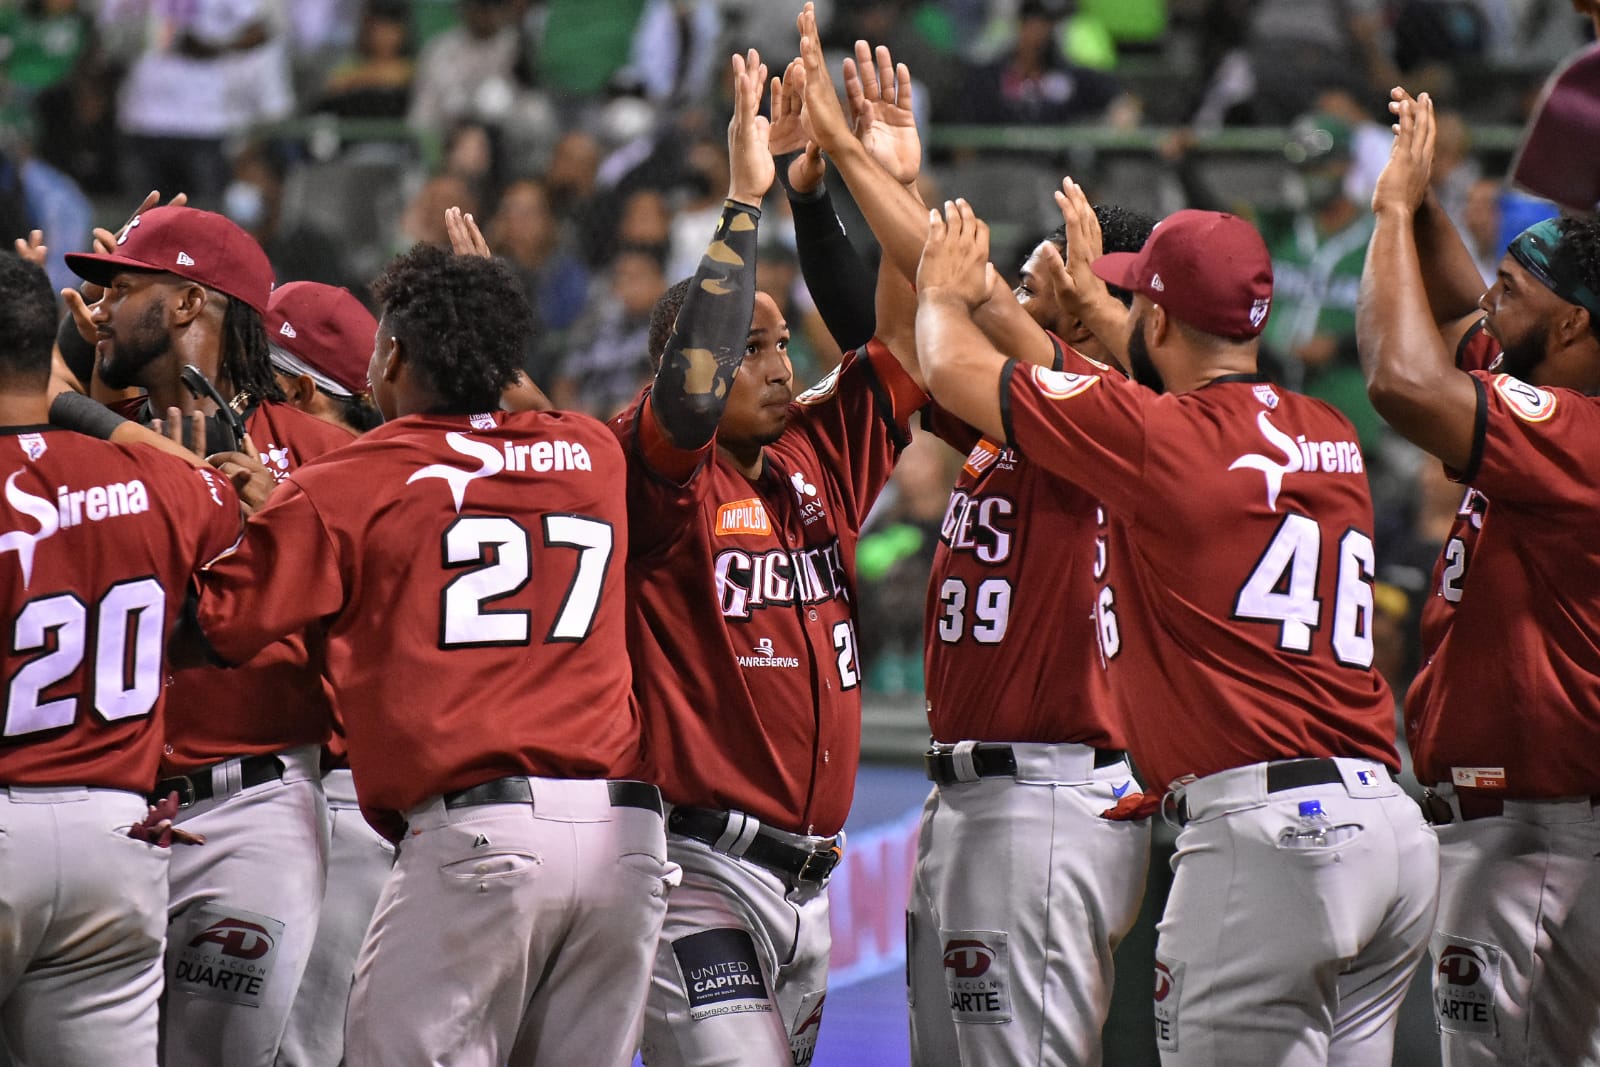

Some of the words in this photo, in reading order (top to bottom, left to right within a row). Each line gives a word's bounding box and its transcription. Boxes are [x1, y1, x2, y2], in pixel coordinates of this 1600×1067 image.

[406, 431, 592, 515] Sirena
[1228, 410, 1364, 513] Sirena
[0, 466, 149, 591] Sirena
[722, 506, 767, 530] IMPULSO
[440, 515, 614, 649] 27
[939, 578, 1012, 644] 39
[1231, 511, 1375, 669] 46
[3, 576, 165, 738] 20
[832, 618, 861, 688] 2
[176, 960, 264, 997] DUARTE
[691, 961, 749, 980] UNITED
[693, 974, 760, 993] CAPITAL
[950, 991, 1001, 1013] ARTE
[731, 1004, 742, 1012] DE
